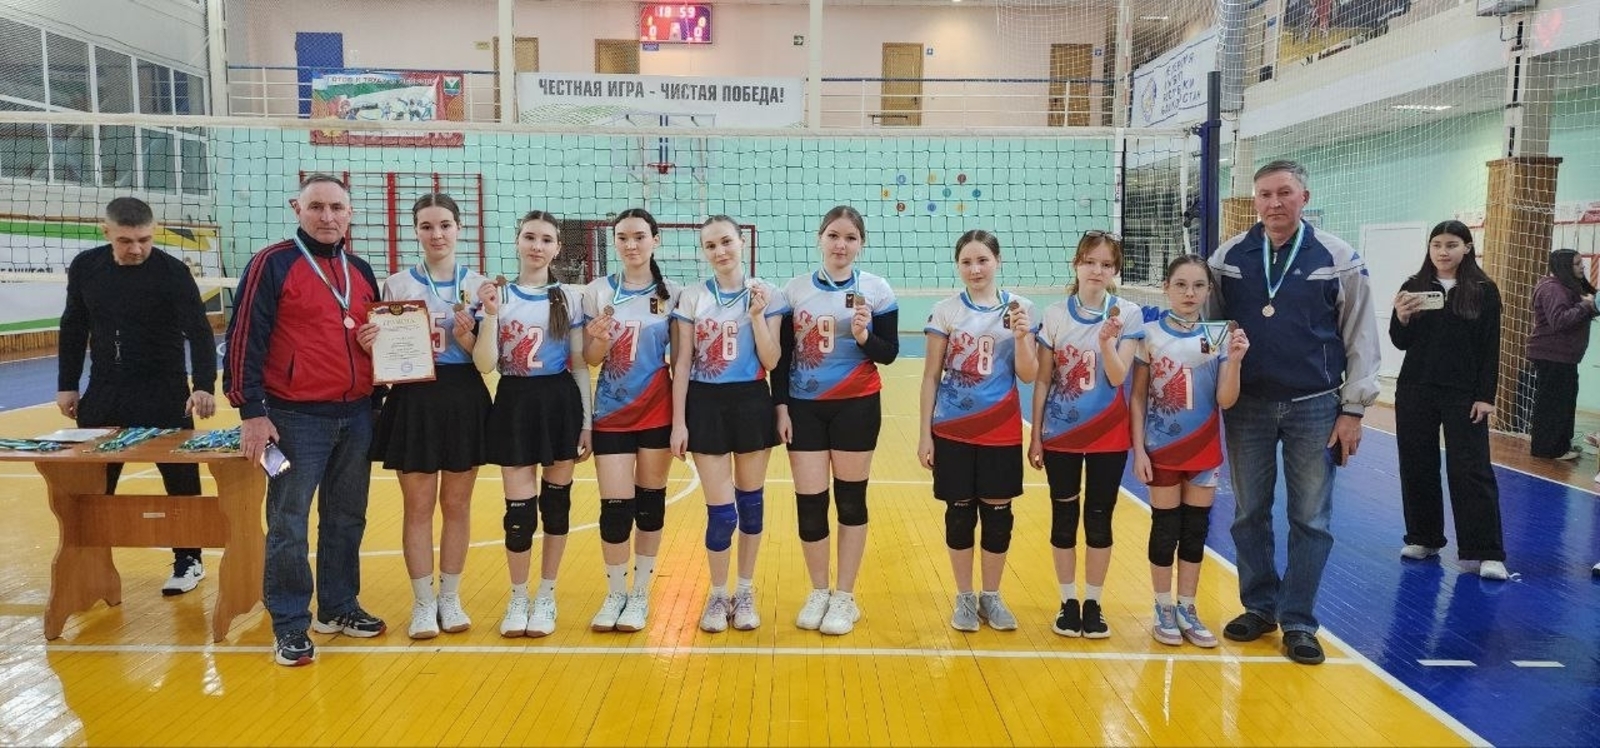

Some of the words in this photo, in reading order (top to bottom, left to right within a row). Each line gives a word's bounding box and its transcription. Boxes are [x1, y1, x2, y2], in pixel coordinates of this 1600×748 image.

[538, 79, 602, 97] ЧЕСТНАЯ
[607, 81, 645, 98] ИГРА
[660, 83, 717, 101] ЧИСТАЯ
[722, 85, 784, 105] ПОБЕДА!
[430, 312, 447, 353] 5
[527, 327, 543, 368] 2
[625, 320, 642, 362] 7
[721, 320, 738, 361] 6
[816, 314, 836, 353] 9
[977, 334, 995, 376] 8
[1080, 350, 1096, 391] 3
[1182, 367, 1194, 410] 1
